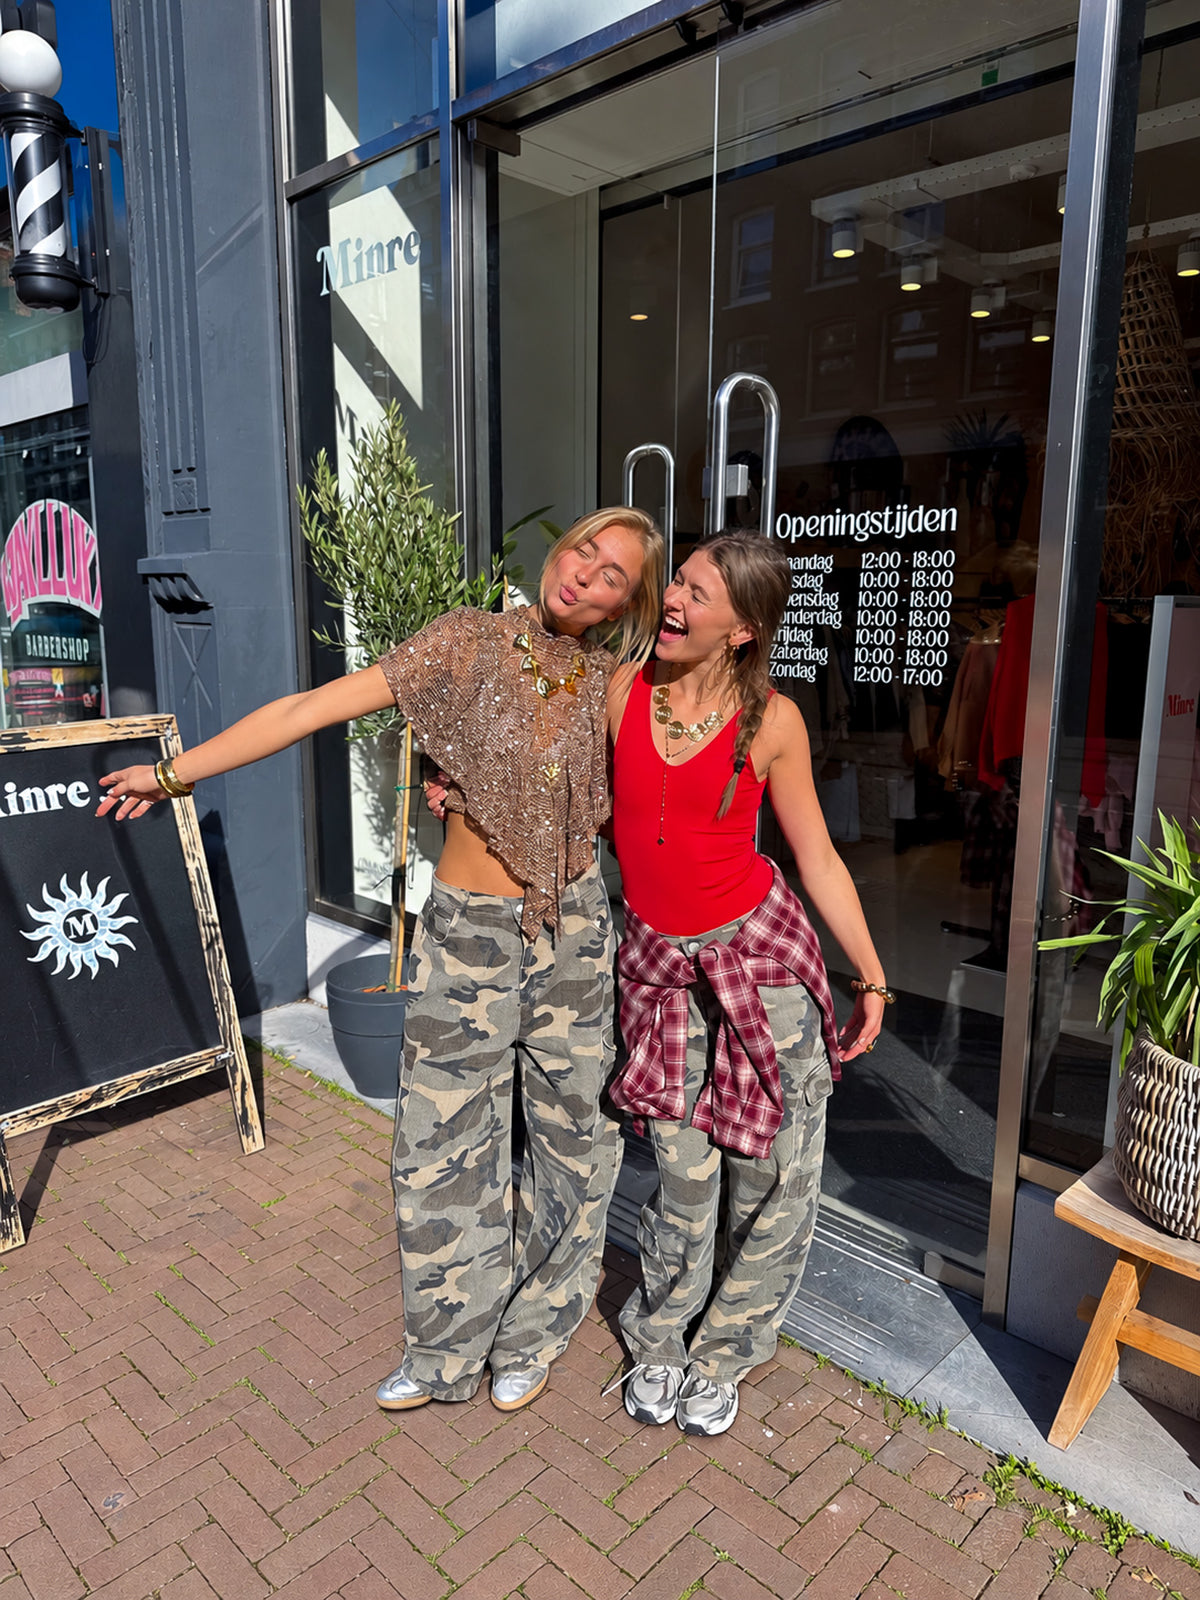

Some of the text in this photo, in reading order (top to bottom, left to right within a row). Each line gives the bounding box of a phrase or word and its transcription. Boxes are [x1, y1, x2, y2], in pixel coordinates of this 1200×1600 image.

[316, 231, 421, 296] Minre
[775, 504, 958, 543] Openingstijden
[787, 554, 834, 573] aandag
[862, 551, 901, 569] 12:00
[913, 550, 955, 568] 18:00
[792, 573, 823, 592] sdag
[860, 571, 900, 588] 10:00
[912, 570, 954, 588] 18:00
[787, 591, 839, 611] ensdag
[858, 590, 898, 607] 10:00
[910, 590, 952, 608] 18:00
[781, 609, 842, 629] nderdag
[857, 609, 897, 627] 10:00
[908, 610, 951, 628] 18:00
[25, 634, 89, 662] BARBERSHOP
[856, 628, 896, 646] 10:00
[907, 629, 949, 647] 18:00
[769, 644, 828, 665] Zaterdag
[854, 647, 894, 665] 10:00
[905, 649, 948, 667] 18:00
[769, 661, 816, 683] Zondag
[853, 666, 892, 683] 12:00
[903, 668, 943, 686] 17:00
[0, 781, 91, 818] inre
[66, 913, 97, 939] M
